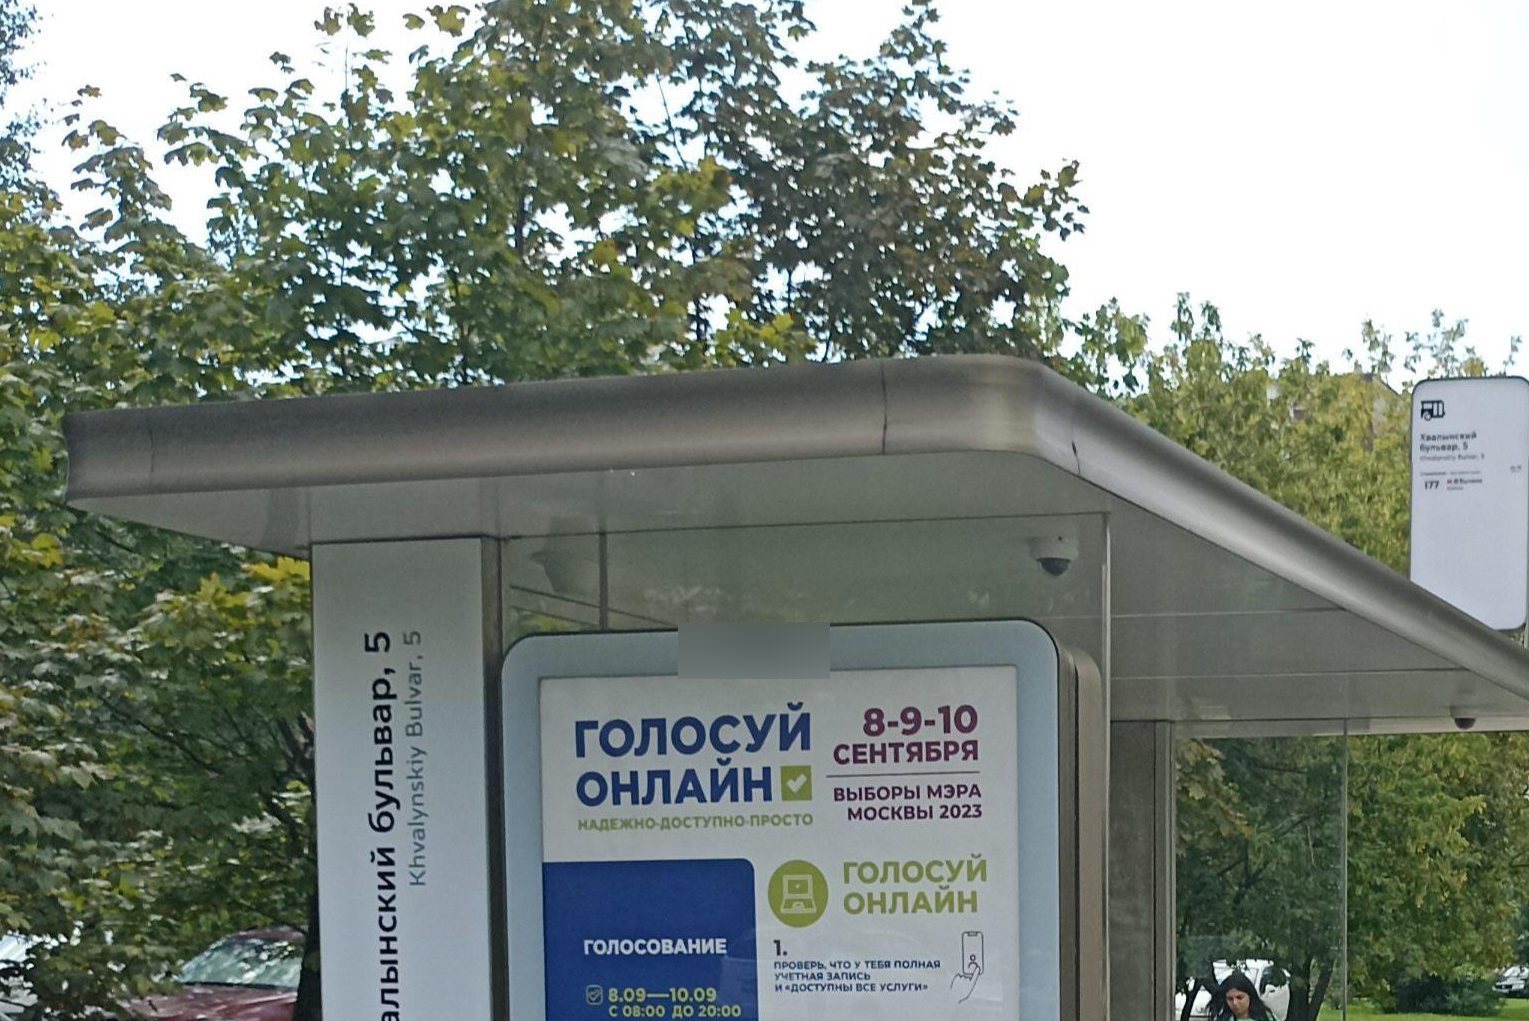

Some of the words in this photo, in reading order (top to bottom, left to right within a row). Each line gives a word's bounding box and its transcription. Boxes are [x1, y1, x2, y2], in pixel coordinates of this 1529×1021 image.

[364, 631, 391, 653] 5
[403, 630, 421, 646] 5
[405, 655, 424, 738] Bulvar,
[575, 701, 811, 758] ГОЛОСУЙ
[863, 704, 978, 737] 8-9-10
[368, 667, 401, 833] бульвар,
[833, 740, 979, 765] СЕНТЯБРЯ
[576, 757, 773, 807] ОНЛАЙН
[833, 785, 920, 802] ВЫБОРЫ
[927, 784, 982, 799] МЭРА
[407, 750, 428, 887] Khvalynskiy
[847, 805, 933, 821] МОСКВЫ
[939, 804, 982, 819] 2023
[843, 853, 988, 885] ГОЛОСУЙ
[843, 884, 978, 915] ОНЛАЙН
[583, 938, 728, 955] ГОЛОСОВАНИЕ
[773, 939, 788, 957] 1.
[773, 960, 827, 971] ПРОВЕРЬ,
[829, 960, 851, 970] ЧТО
[854, 960, 861, 970] У
[864, 960, 891, 970] ТЕБЯ
[893, 959, 941, 969] ПОЛНАЯ
[775, 971, 824, 981] УЧЕТНАЯ
[826, 971, 871, 981] ЗАПИСЬ
[775, 983, 783, 992] И
[784, 982, 853, 993] «ДОСТУПНЫ
[855, 982, 877, 992] ВСЕ
[879, 982, 928, 992] УСЛУГИ»
[608, 1005, 618, 1018] С
[622, 1005, 665, 1018] 08:00
[671, 1005, 694, 1019] ДО
[698, 1004, 741, 1018] 20:00
